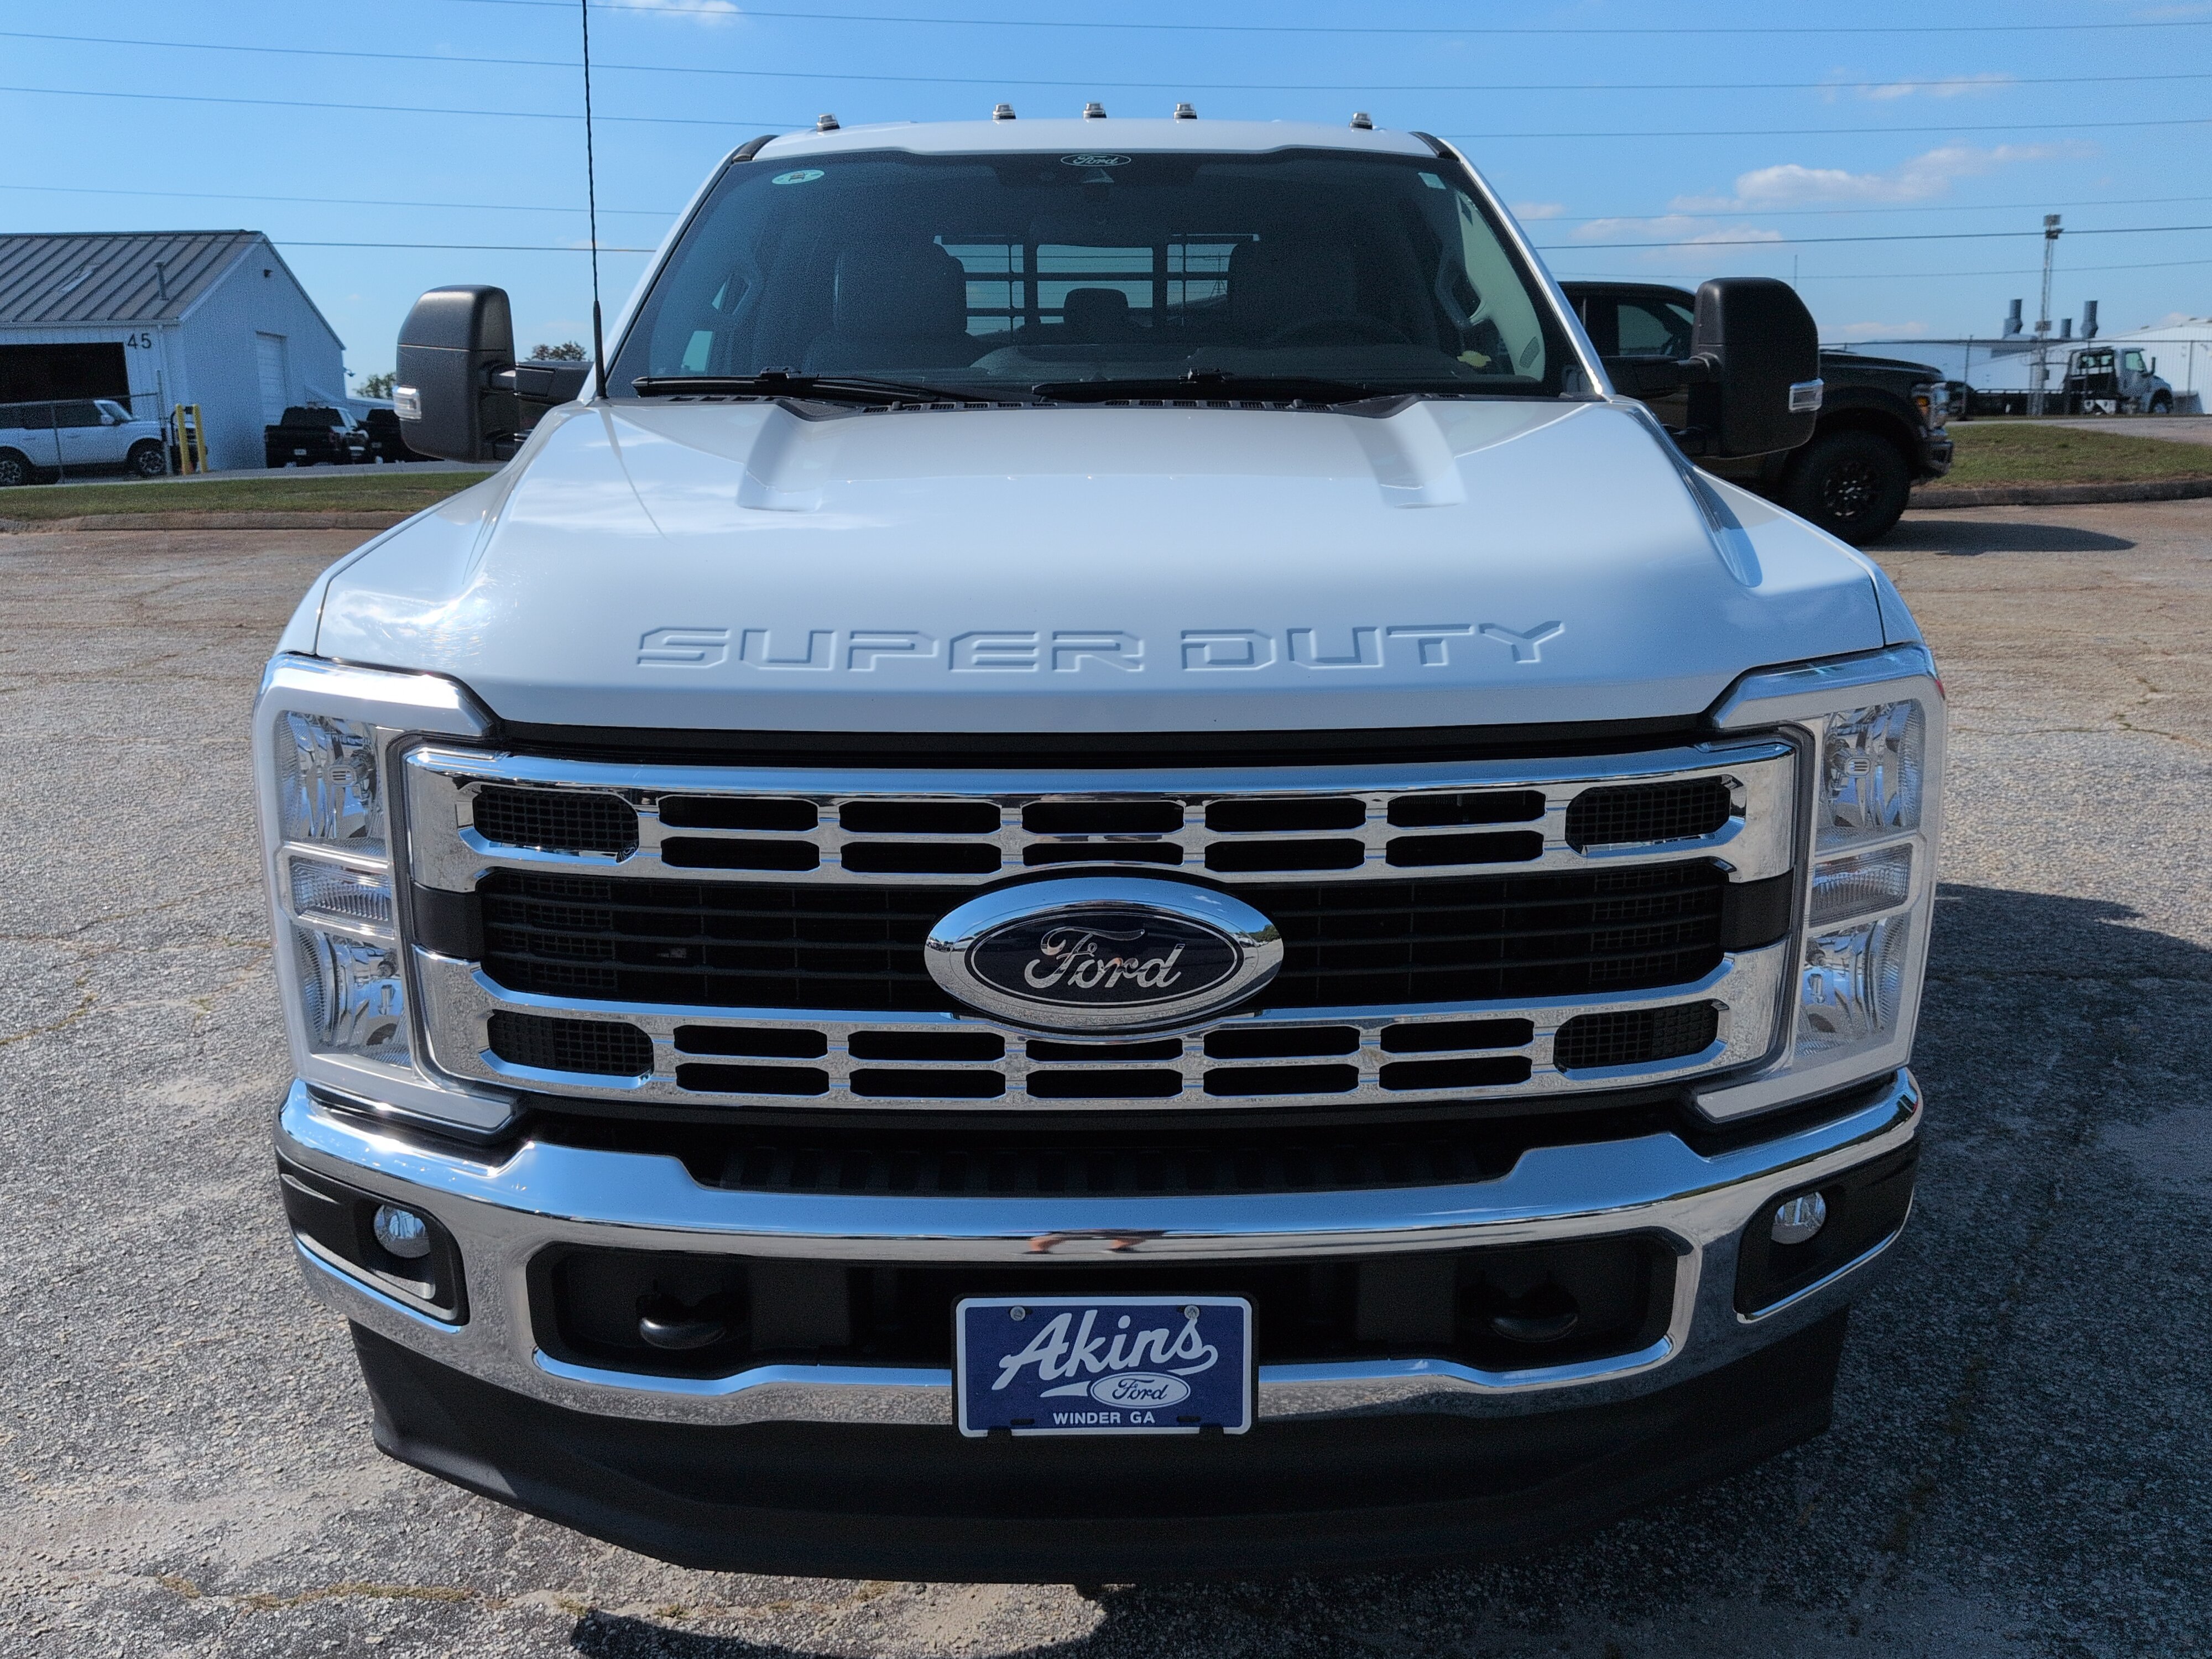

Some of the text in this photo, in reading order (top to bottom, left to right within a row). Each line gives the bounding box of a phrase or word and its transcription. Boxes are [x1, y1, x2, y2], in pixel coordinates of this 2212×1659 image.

[1073, 155, 1119, 164] Ford
[128, 333, 152, 349] 45
[639, 620, 1565, 673] SUPER DUTY
[1024, 926, 1186, 989] Ford
[992, 1309, 1218, 1390] Akins
[1112, 1378, 1169, 1400] Ford
[1053, 1411, 1156, 1425] WINDER GA
